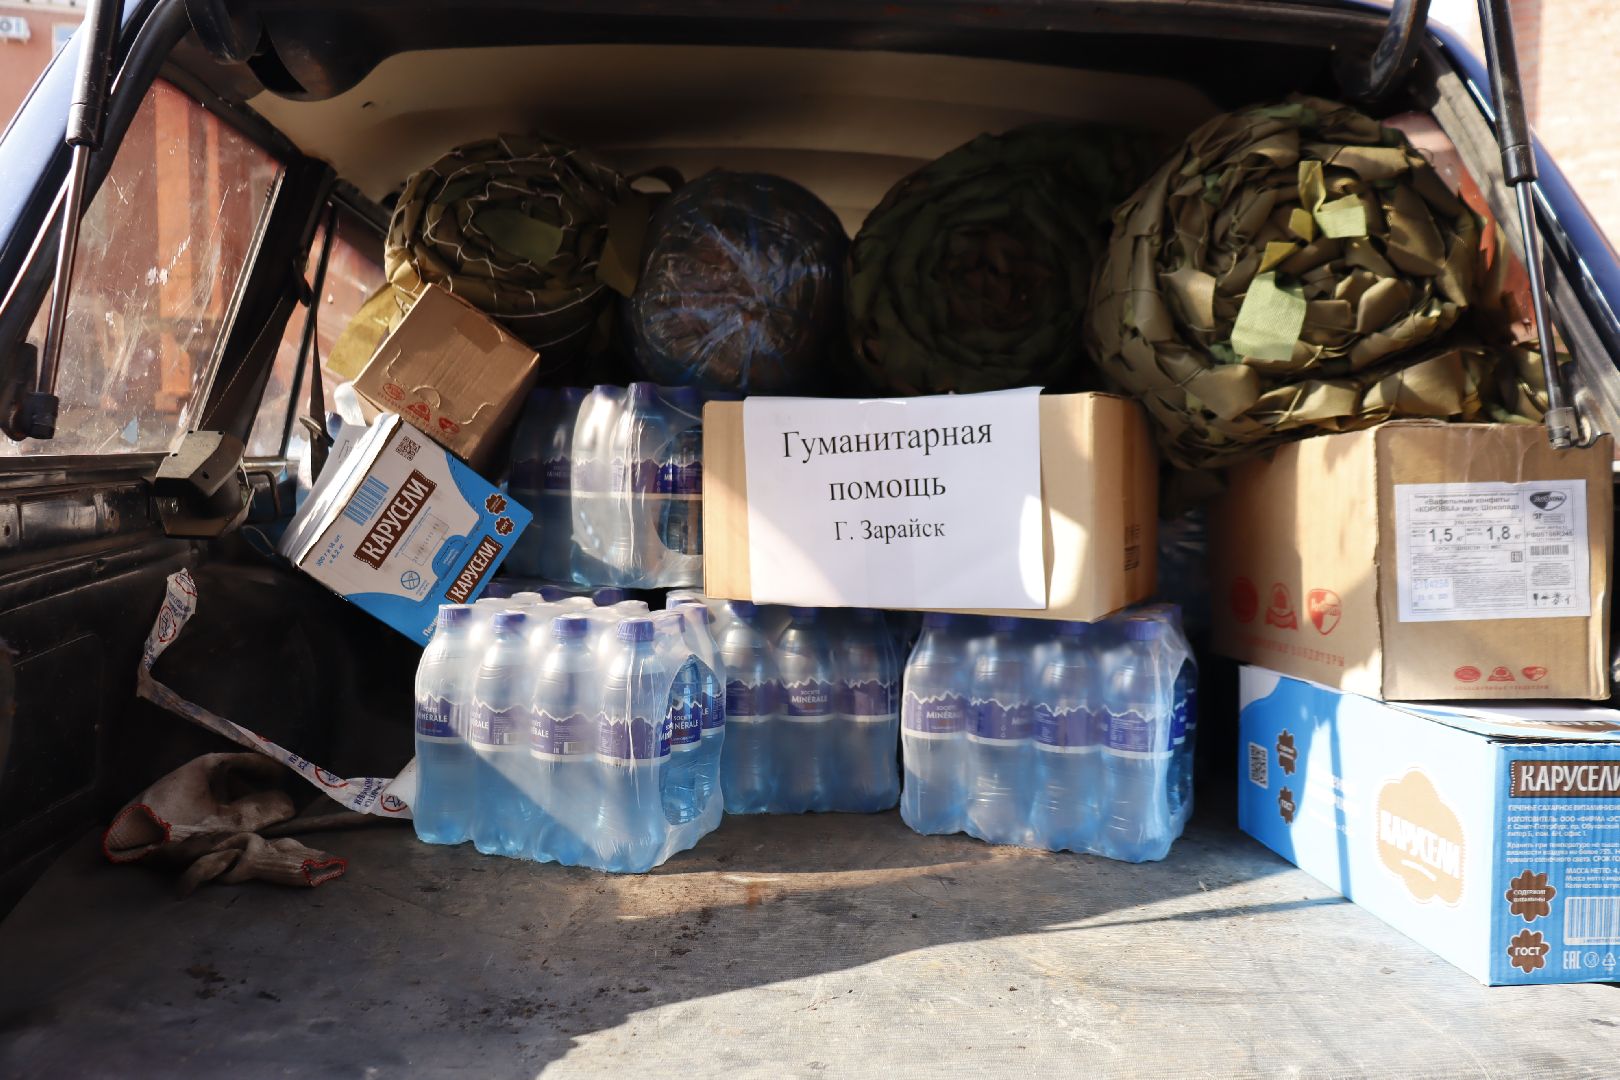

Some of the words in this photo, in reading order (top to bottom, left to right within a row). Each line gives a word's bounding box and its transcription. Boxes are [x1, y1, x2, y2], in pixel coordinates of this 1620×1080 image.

[781, 423, 993, 463] Гуманитарная
[828, 477, 947, 501] помощь
[361, 476, 429, 562] КАРУСЕЛИ
[835, 521, 854, 541] Г.
[860, 518, 946, 544] Зарайск
[1428, 527, 1454, 544] 1,5
[1486, 525, 1511, 542] 1,8
[450, 539, 497, 600] КАРУСЕЛИ
[1379, 809, 1461, 878] КАРУСЕЛИ
[1514, 947, 1541, 956] ГОСТ
